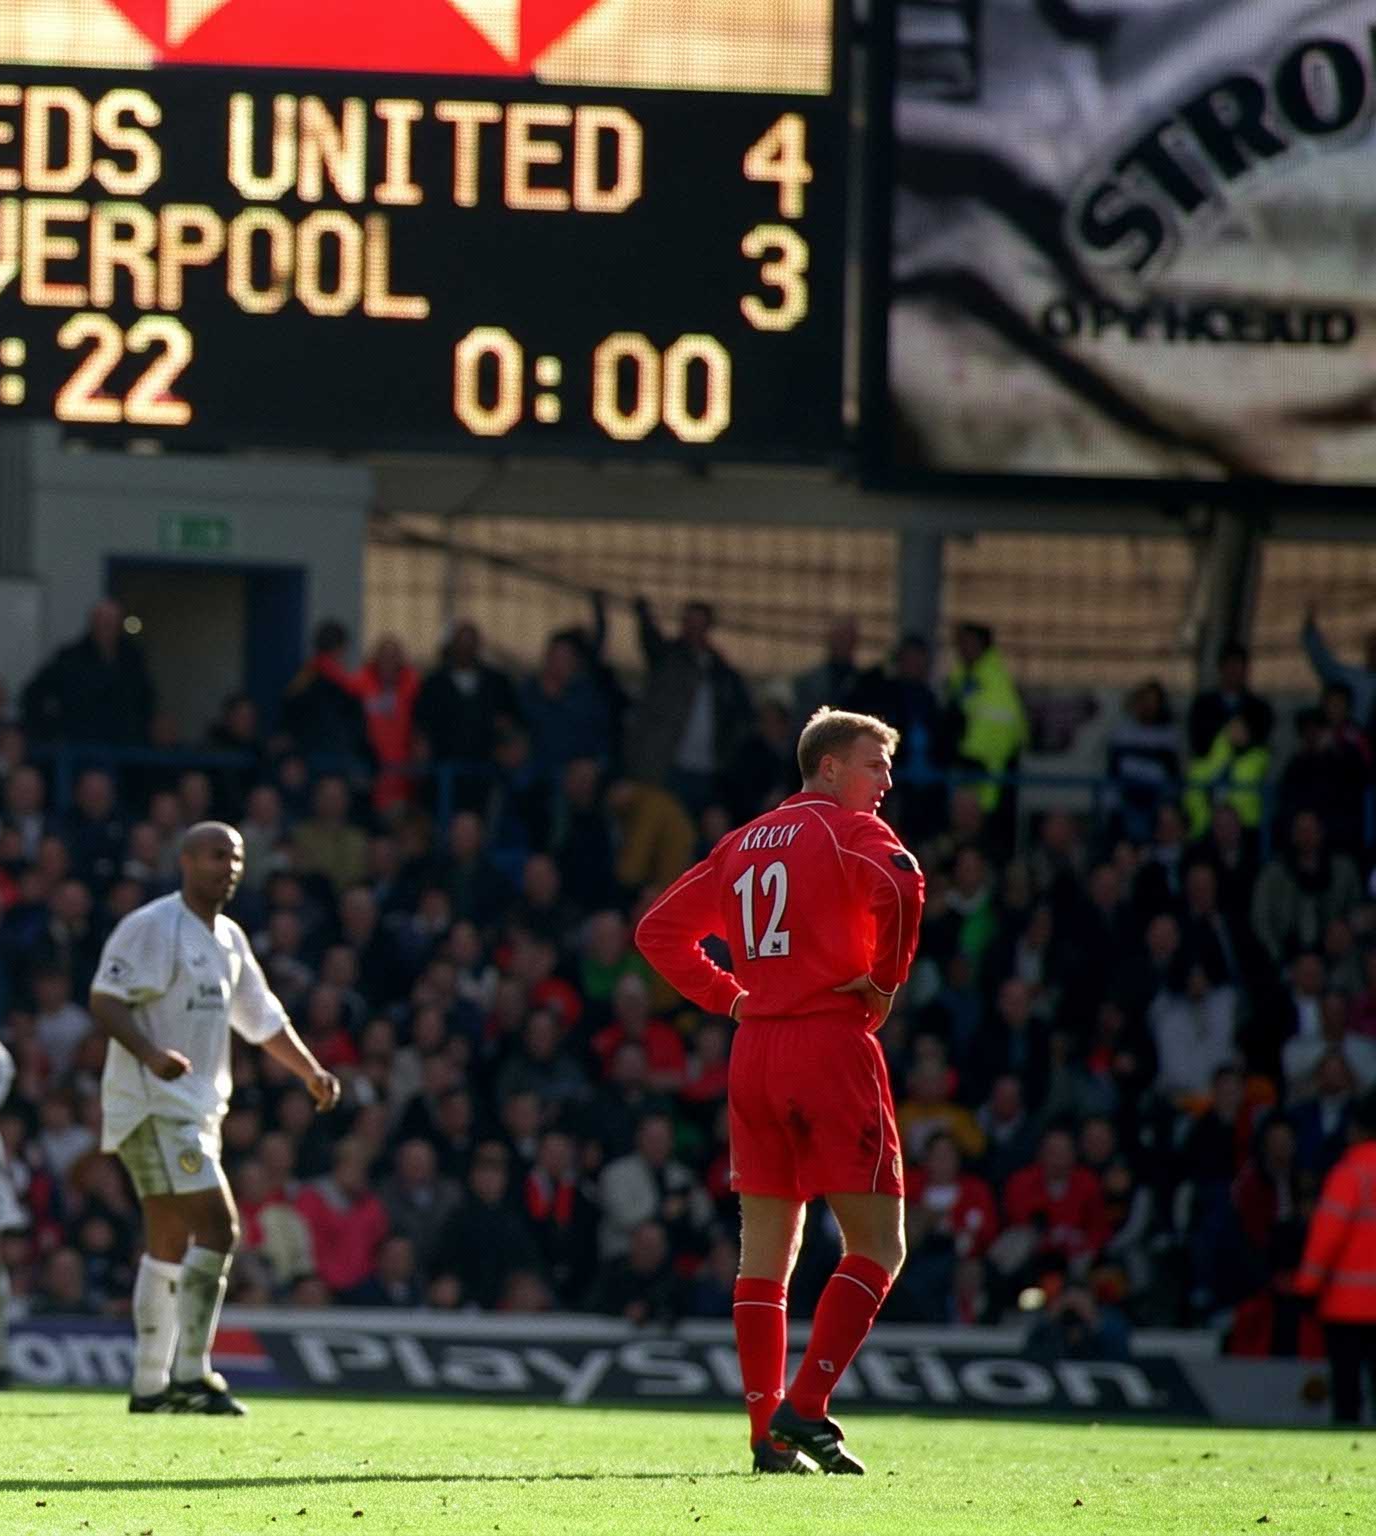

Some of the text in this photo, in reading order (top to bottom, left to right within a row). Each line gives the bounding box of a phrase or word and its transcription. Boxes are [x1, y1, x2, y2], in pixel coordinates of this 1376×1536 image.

[228, 92, 643, 213] UNITED
[743, 112, 813, 219] 4
[1079, 25, 1376, 273] STRO
[740, 224, 809, 332] 3
[732, 861, 790, 960] 12
